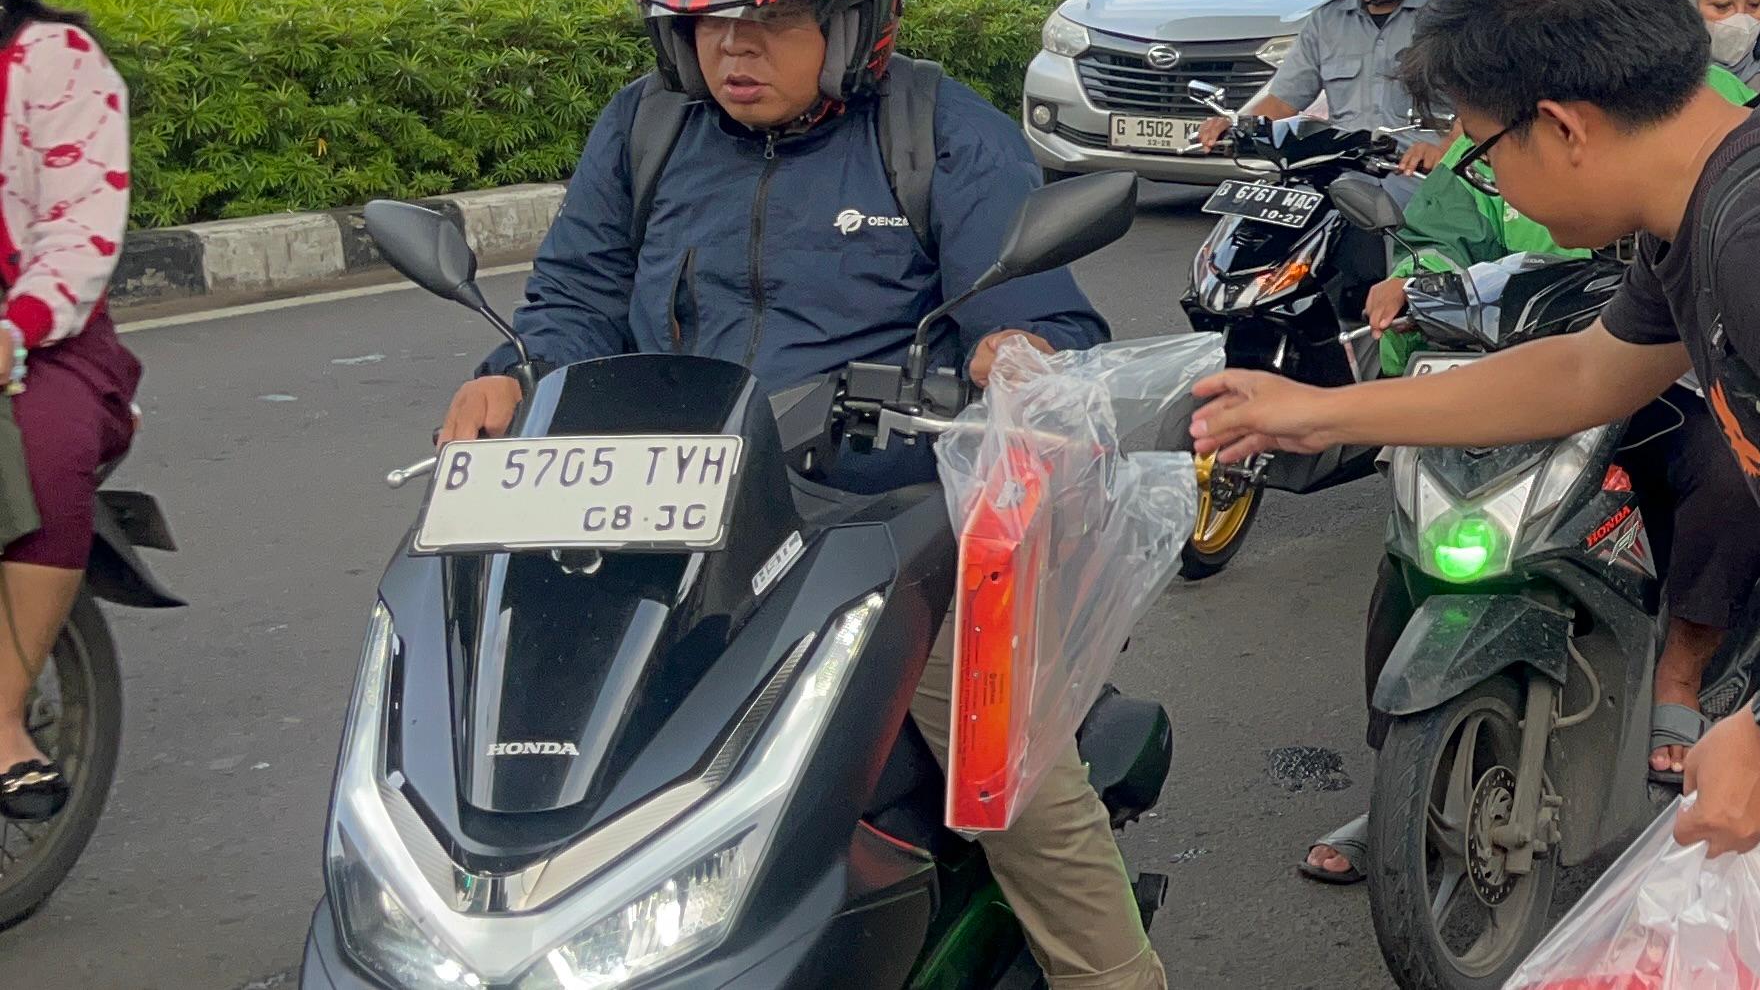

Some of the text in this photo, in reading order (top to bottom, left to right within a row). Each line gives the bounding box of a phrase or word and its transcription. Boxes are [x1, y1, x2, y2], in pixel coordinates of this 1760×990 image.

[1116, 118, 1126, 136] G
[1136, 120, 1174, 138] 1502
[1217, 183, 1232, 196] B
[1235, 186, 1279, 203] 6761
[1260, 208, 1303, 224] 10-27
[445, 446, 727, 491] B 5705 TYH
[1586, 505, 1631, 547] HONDA
[486, 742, 580, 756] HONDA
